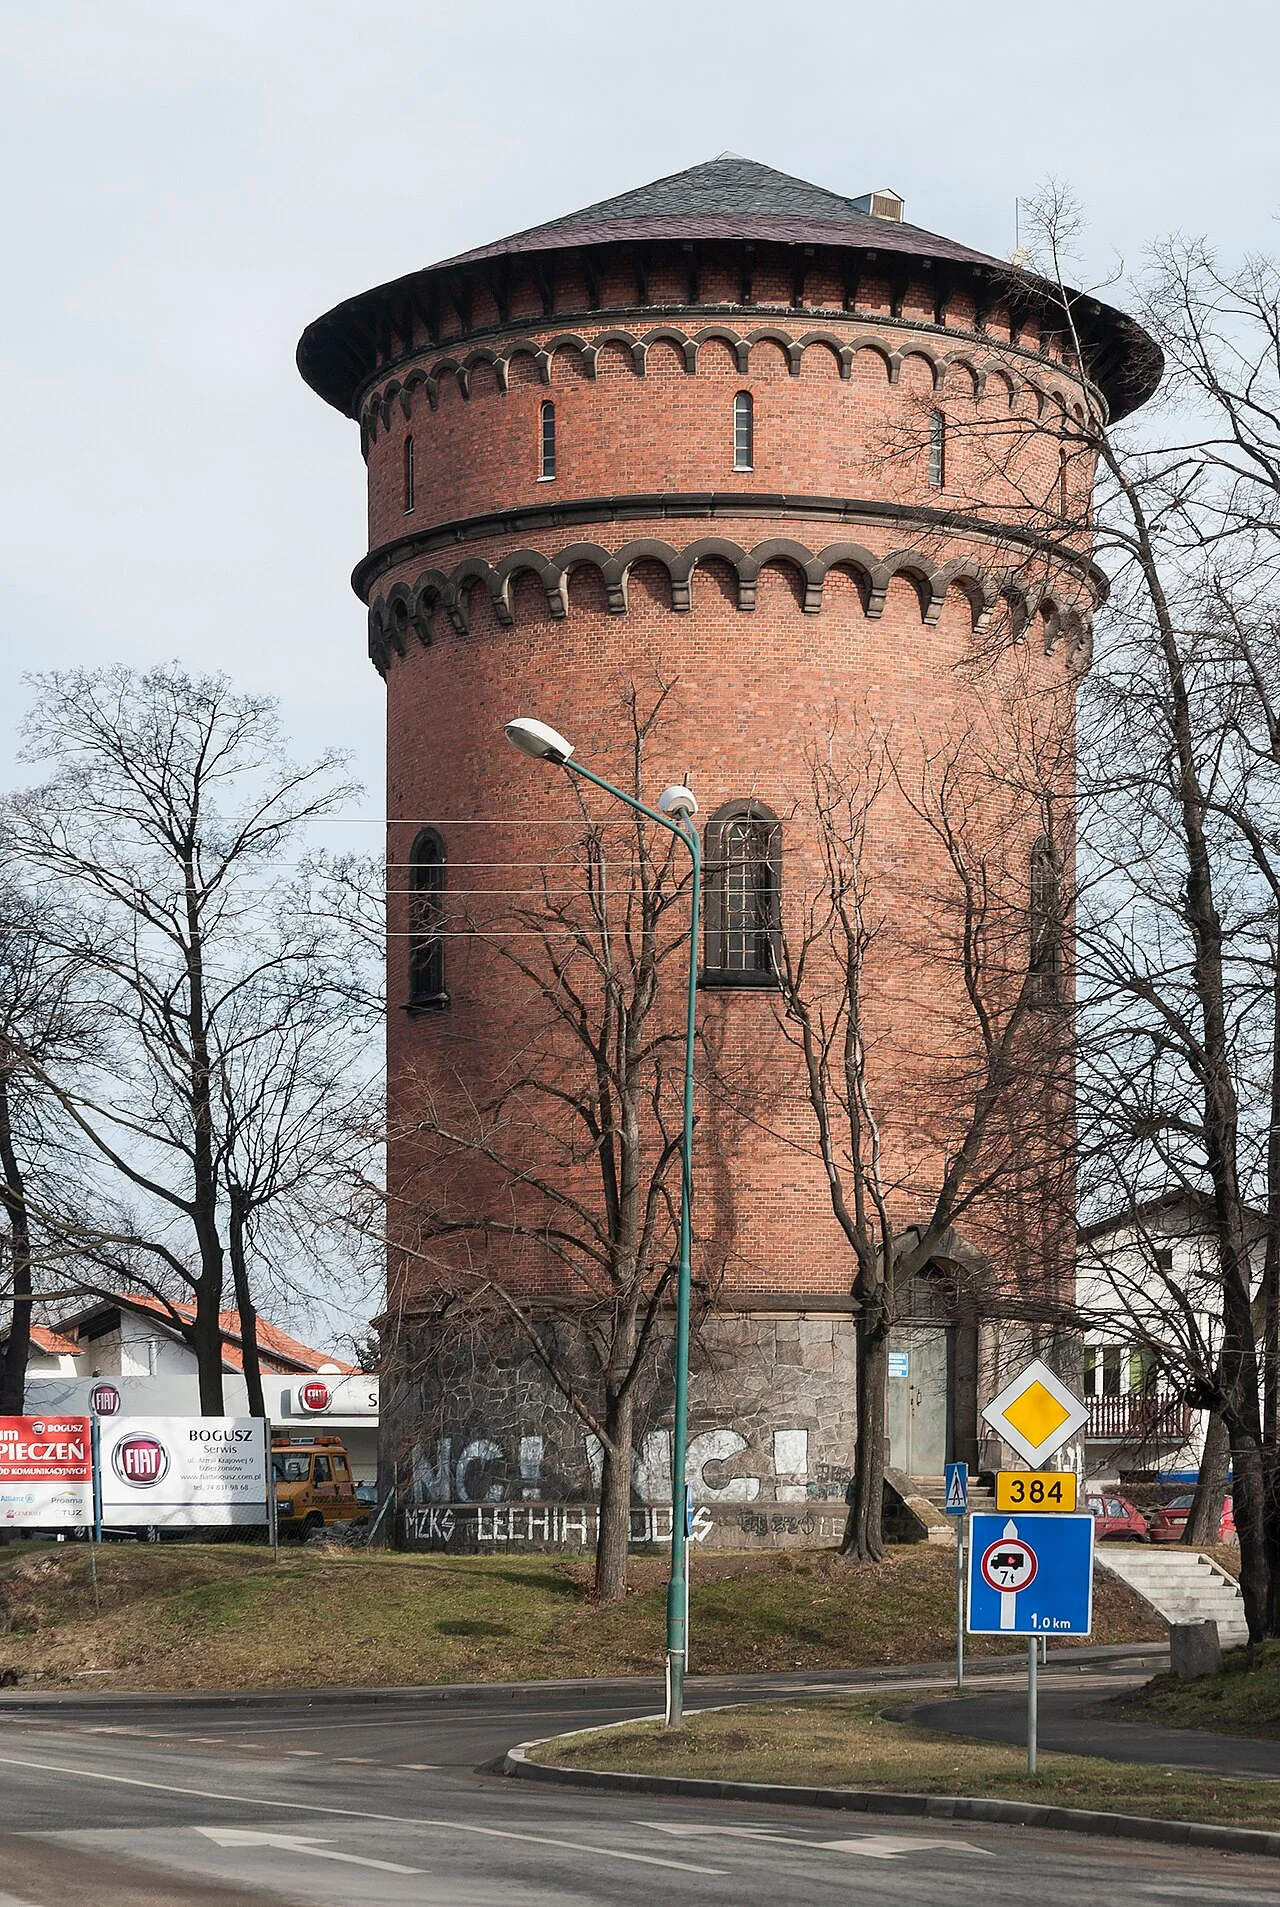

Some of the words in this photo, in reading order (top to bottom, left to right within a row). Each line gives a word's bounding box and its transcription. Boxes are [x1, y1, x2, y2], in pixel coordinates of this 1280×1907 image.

[95, 1392, 115, 1410] FIAT
[47, 1424, 84, 1433] BOGUSZ
[189, 1429, 253, 1442] BOGUSZ
[0, 1438, 84, 1460] PIECZEŃ
[203, 1444, 237, 1454] Serwis
[125, 1448, 159, 1474] FIAT
[218, 1457, 248, 1465] Krajowej
[12, 1467, 87, 1476] KOMUNIKACYJNYCH
[180, 1473, 262, 1481] www.fiatbogusz.com.pl
[1009, 1479, 1064, 1504] 384
[405, 1507, 456, 1542] MZKS
[477, 1506, 588, 1544] LECHIA
[1030, 1612, 1051, 1630] 1,0
[1053, 1617, 1071, 1629] km
